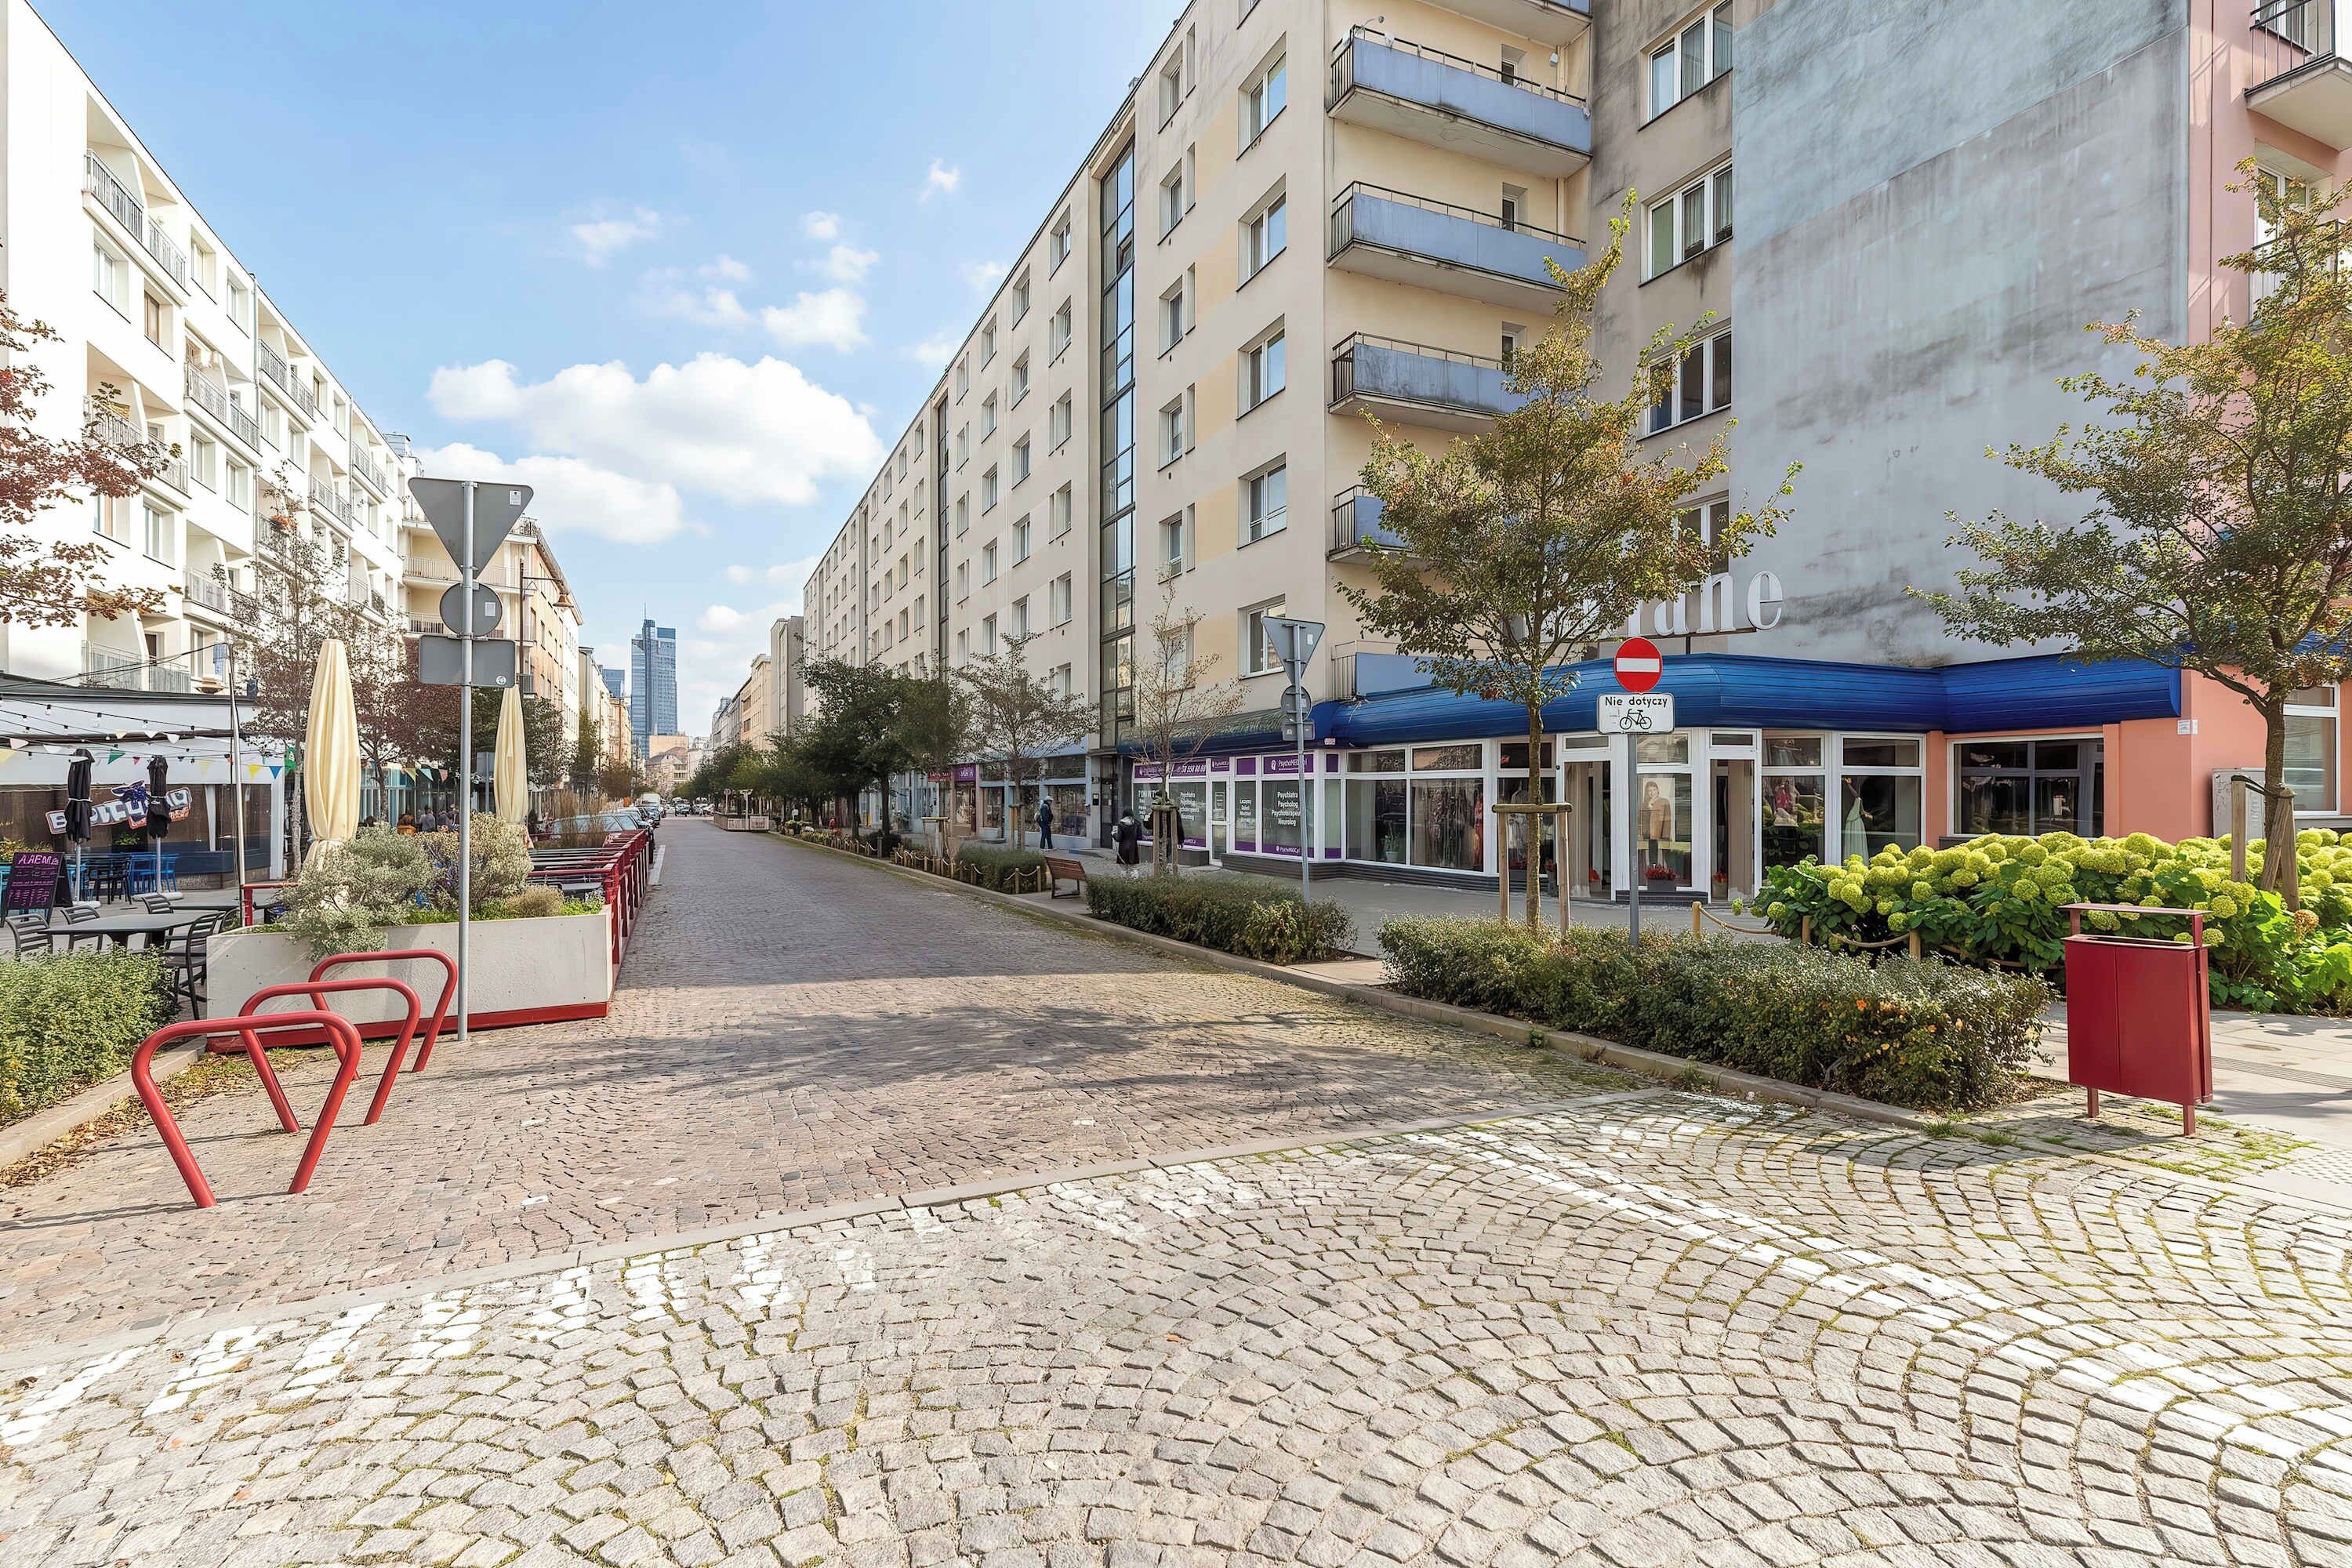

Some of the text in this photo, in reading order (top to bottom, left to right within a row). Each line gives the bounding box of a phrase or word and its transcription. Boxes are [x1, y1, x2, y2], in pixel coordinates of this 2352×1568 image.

[1605, 696, 1668, 708] Nie dotyczy
[1277, 791, 1298, 800] Psychiatra
[1277, 818, 1297, 826] Neurolog
